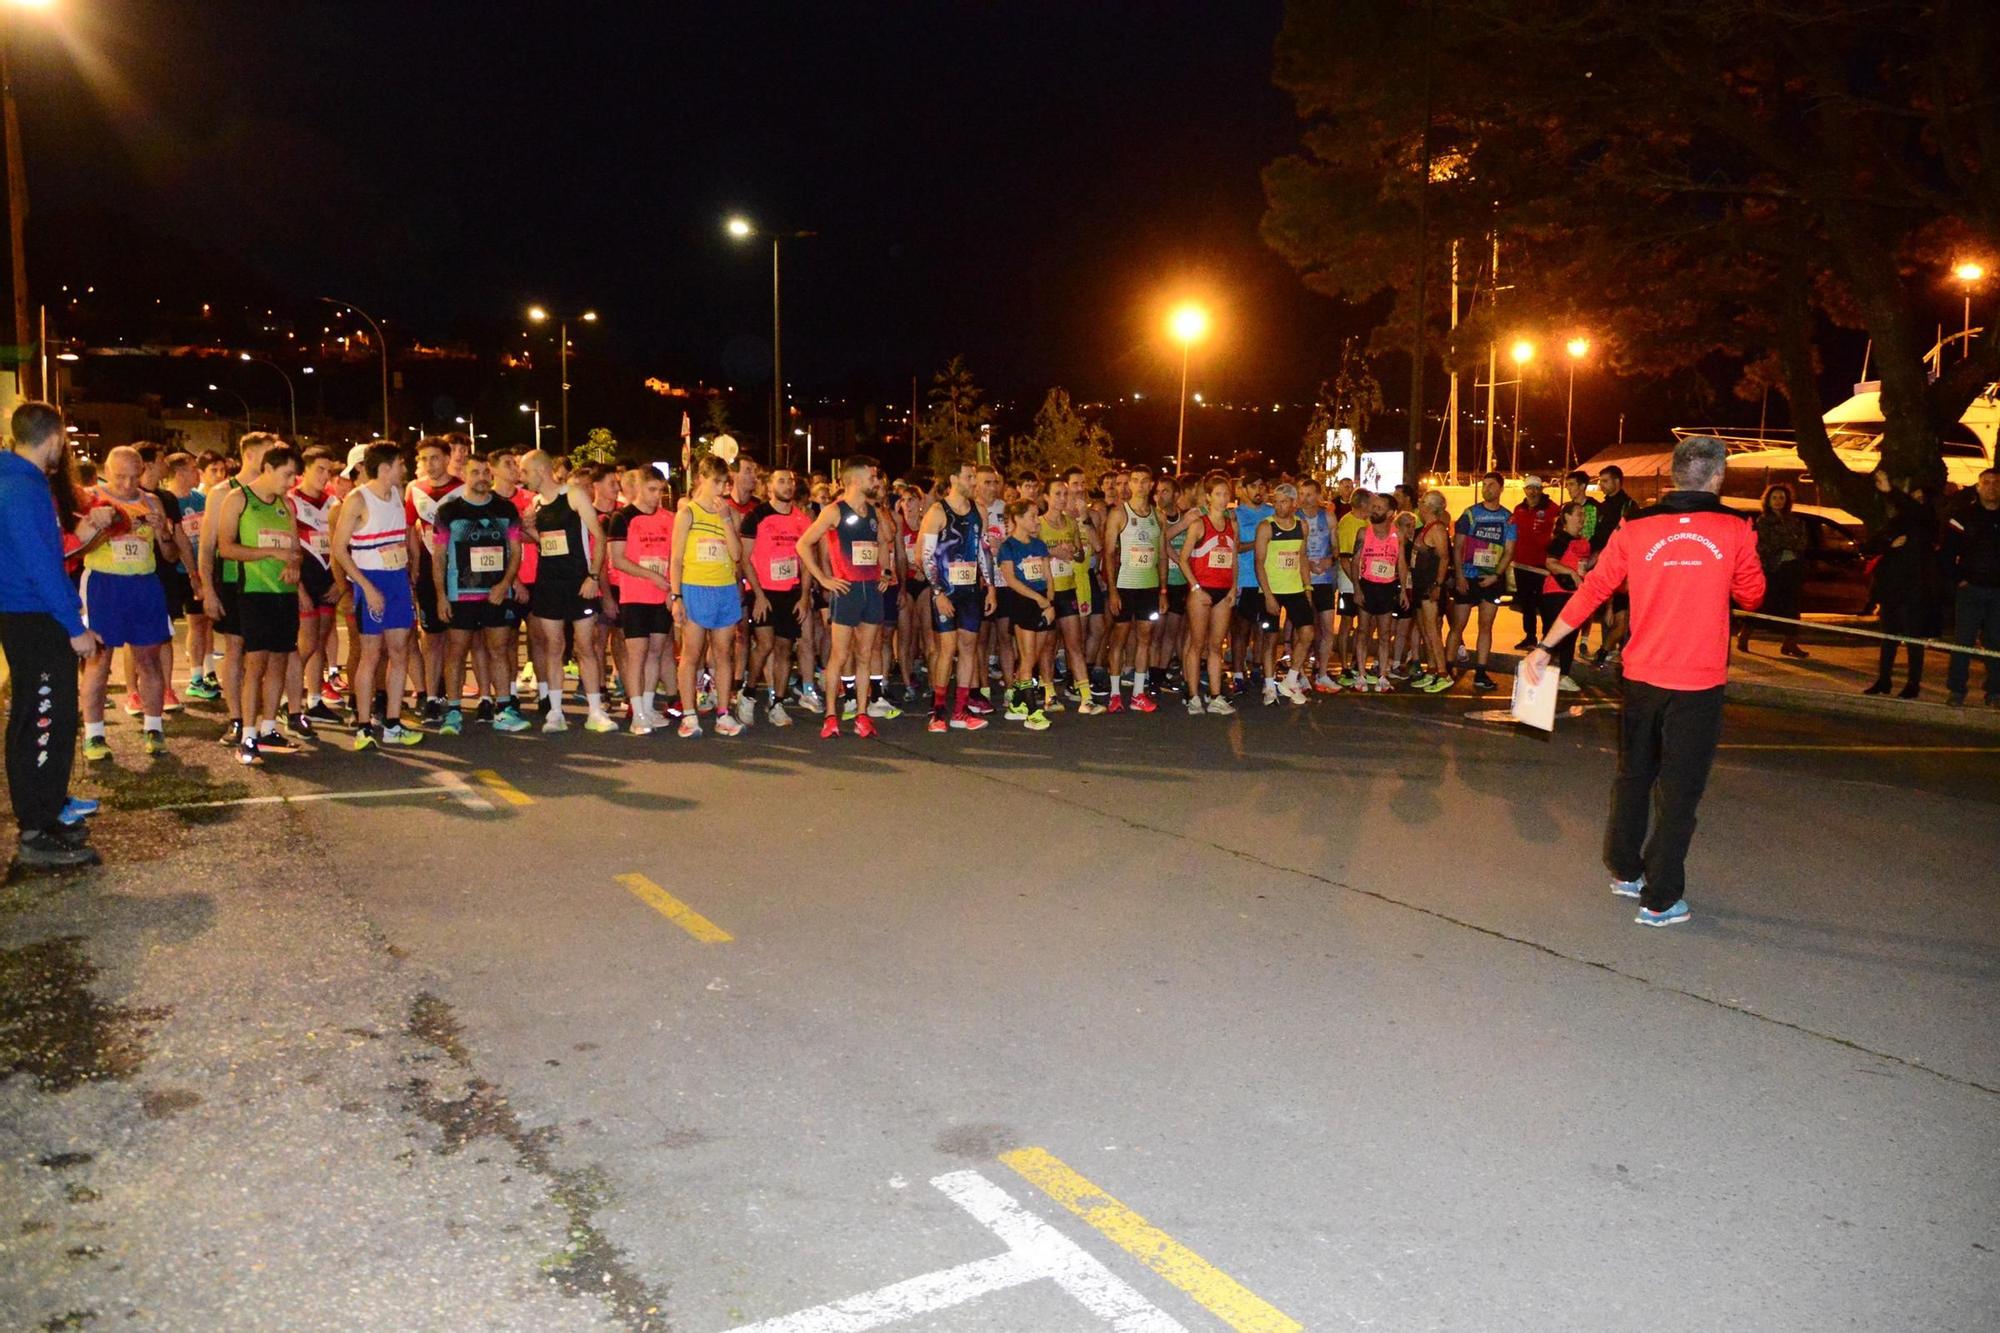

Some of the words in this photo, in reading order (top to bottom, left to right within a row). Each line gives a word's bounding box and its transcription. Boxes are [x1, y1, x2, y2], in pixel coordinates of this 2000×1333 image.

[125, 545, 139, 555] 92
[708, 545, 717, 556] 12
[1645, 539, 1667, 561] CLUBE
[1667, 532, 1723, 560] CORREDOIRAS
[862, 550, 872, 560] 53
[1138, 555, 1148, 564] 43
[480, 555, 495, 566] 126
